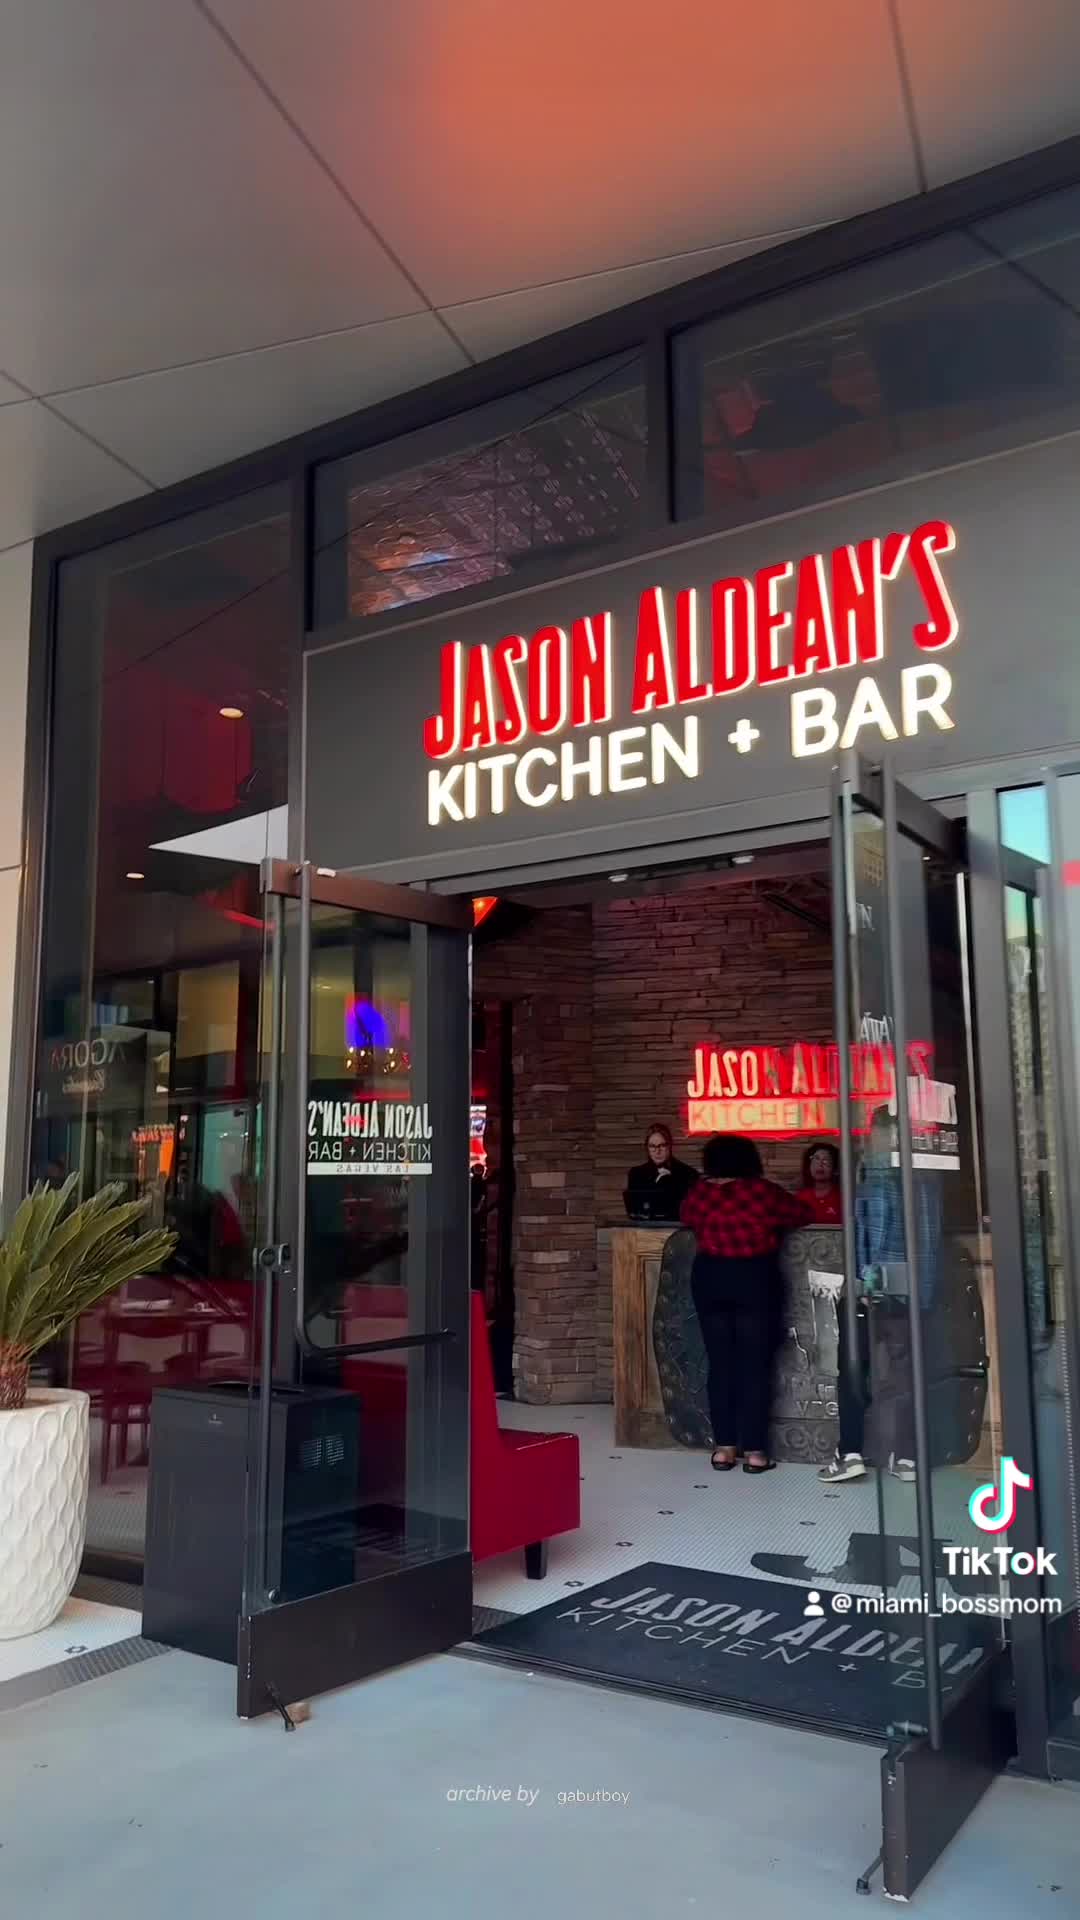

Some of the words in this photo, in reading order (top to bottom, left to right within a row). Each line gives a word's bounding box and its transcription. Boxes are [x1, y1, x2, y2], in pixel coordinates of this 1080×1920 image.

[423, 611, 612, 759] JASON
[631, 519, 959, 714] ALDEAN'S
[427, 715, 699, 825] KITCHEN
[791, 662, 956, 758] BAR
[687, 1048, 780, 1098] JASON
[556, 1607, 812, 1665] KITCHEN
[590, 1587, 781, 1636] JASON
